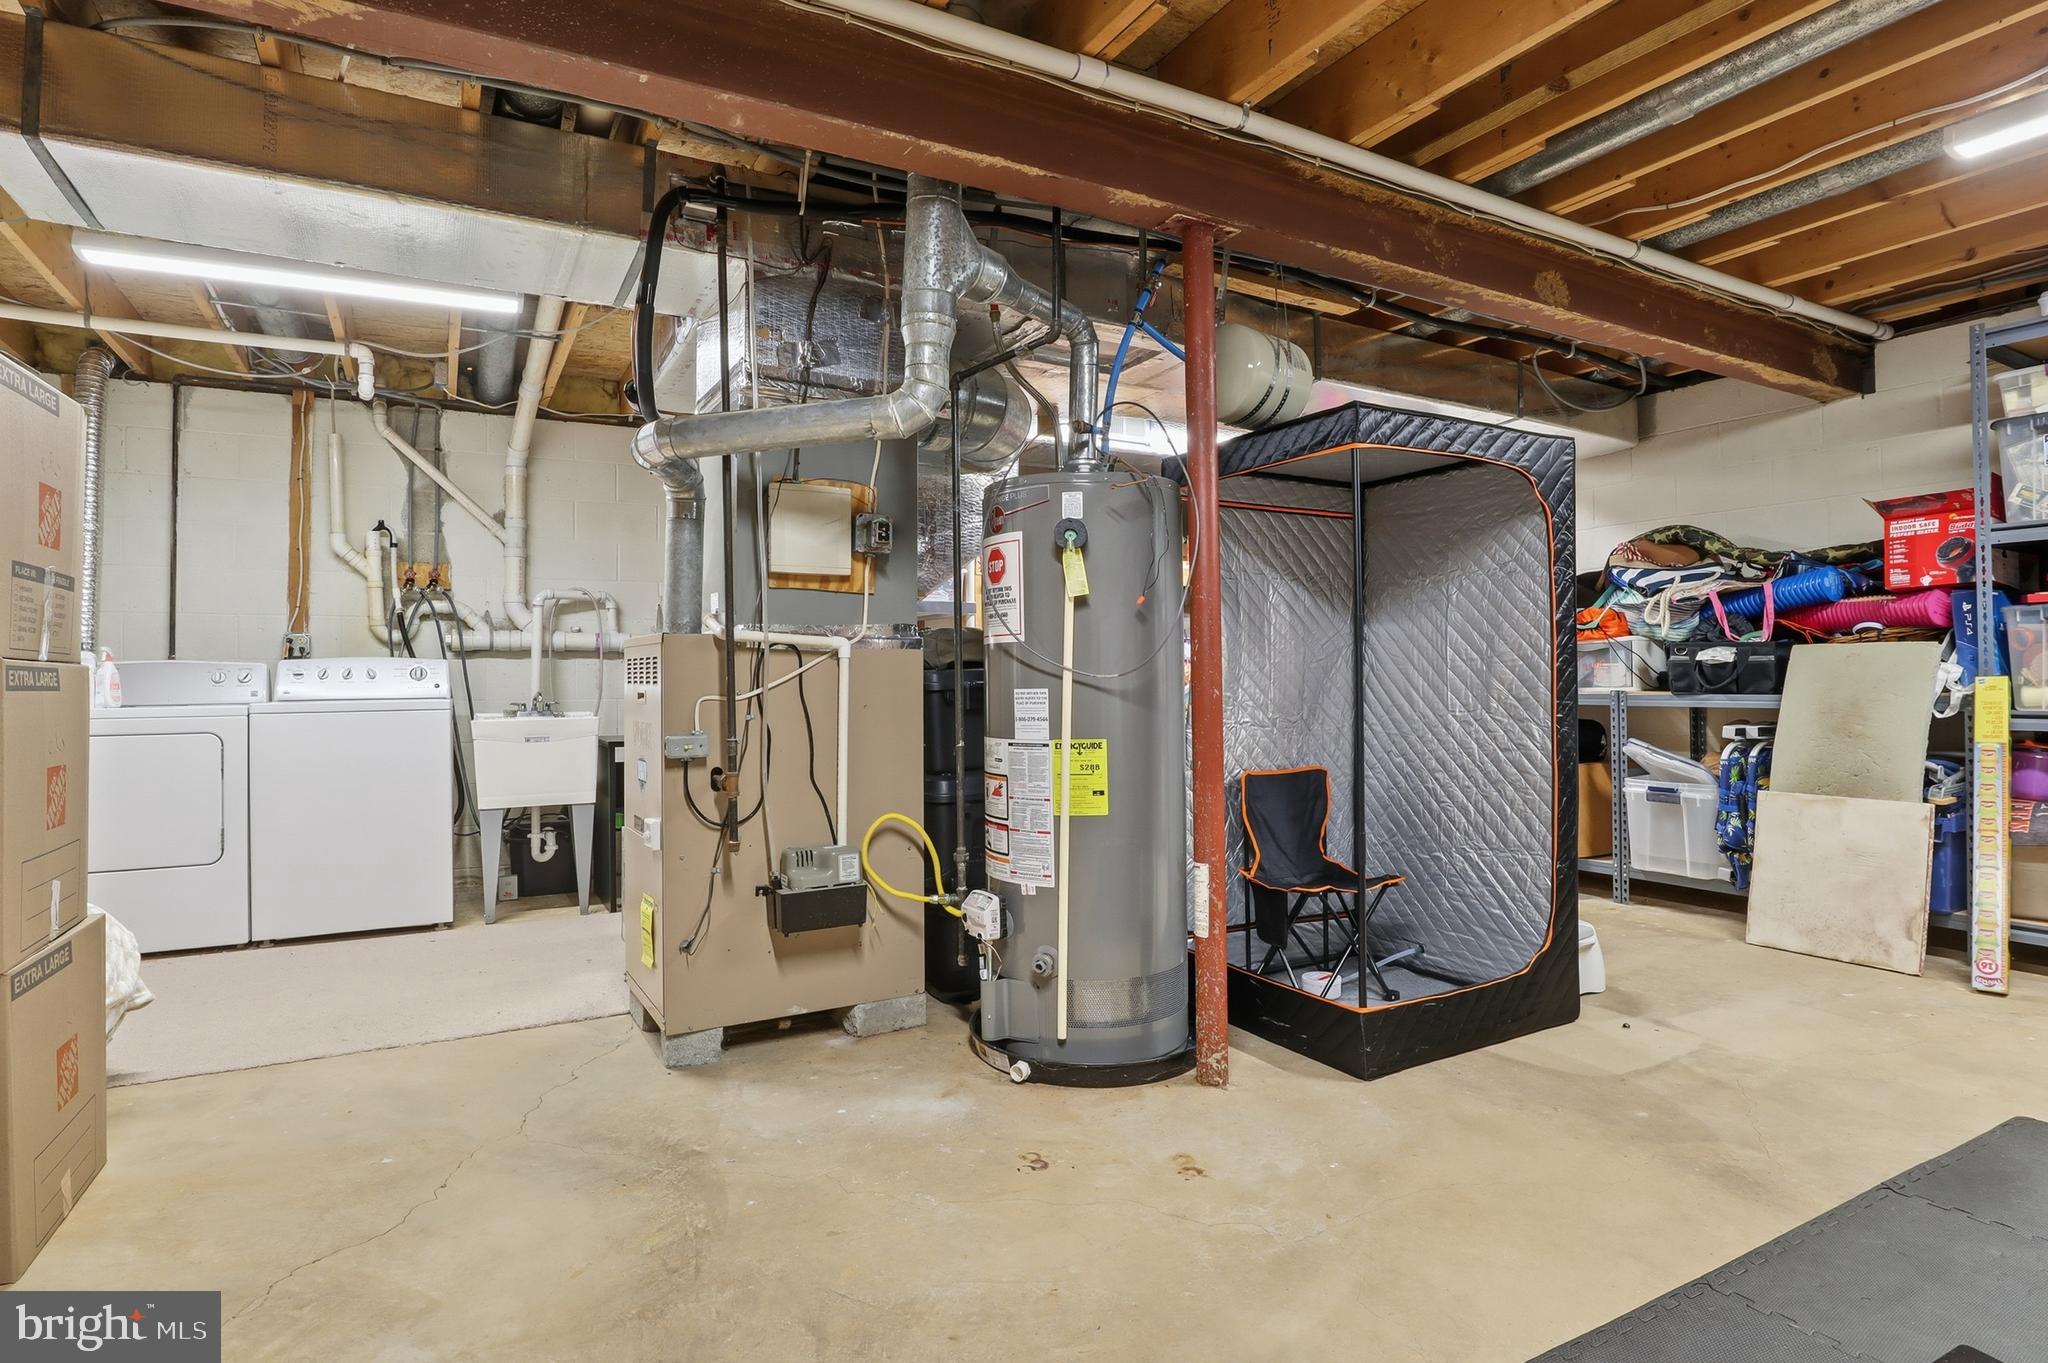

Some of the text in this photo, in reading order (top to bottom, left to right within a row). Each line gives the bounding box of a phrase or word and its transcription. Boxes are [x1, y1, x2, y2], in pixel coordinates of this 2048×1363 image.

[28, 381, 57, 411] LARGE
[1891, 520, 1936, 532] INDOOR SAFE
[988, 560, 1004, 573] STOP
[1964, 613, 1974, 635] PS4
[8, 669, 58, 687] EXTRA LARGE
[14, 946, 70, 994] EXTRA LARGE
